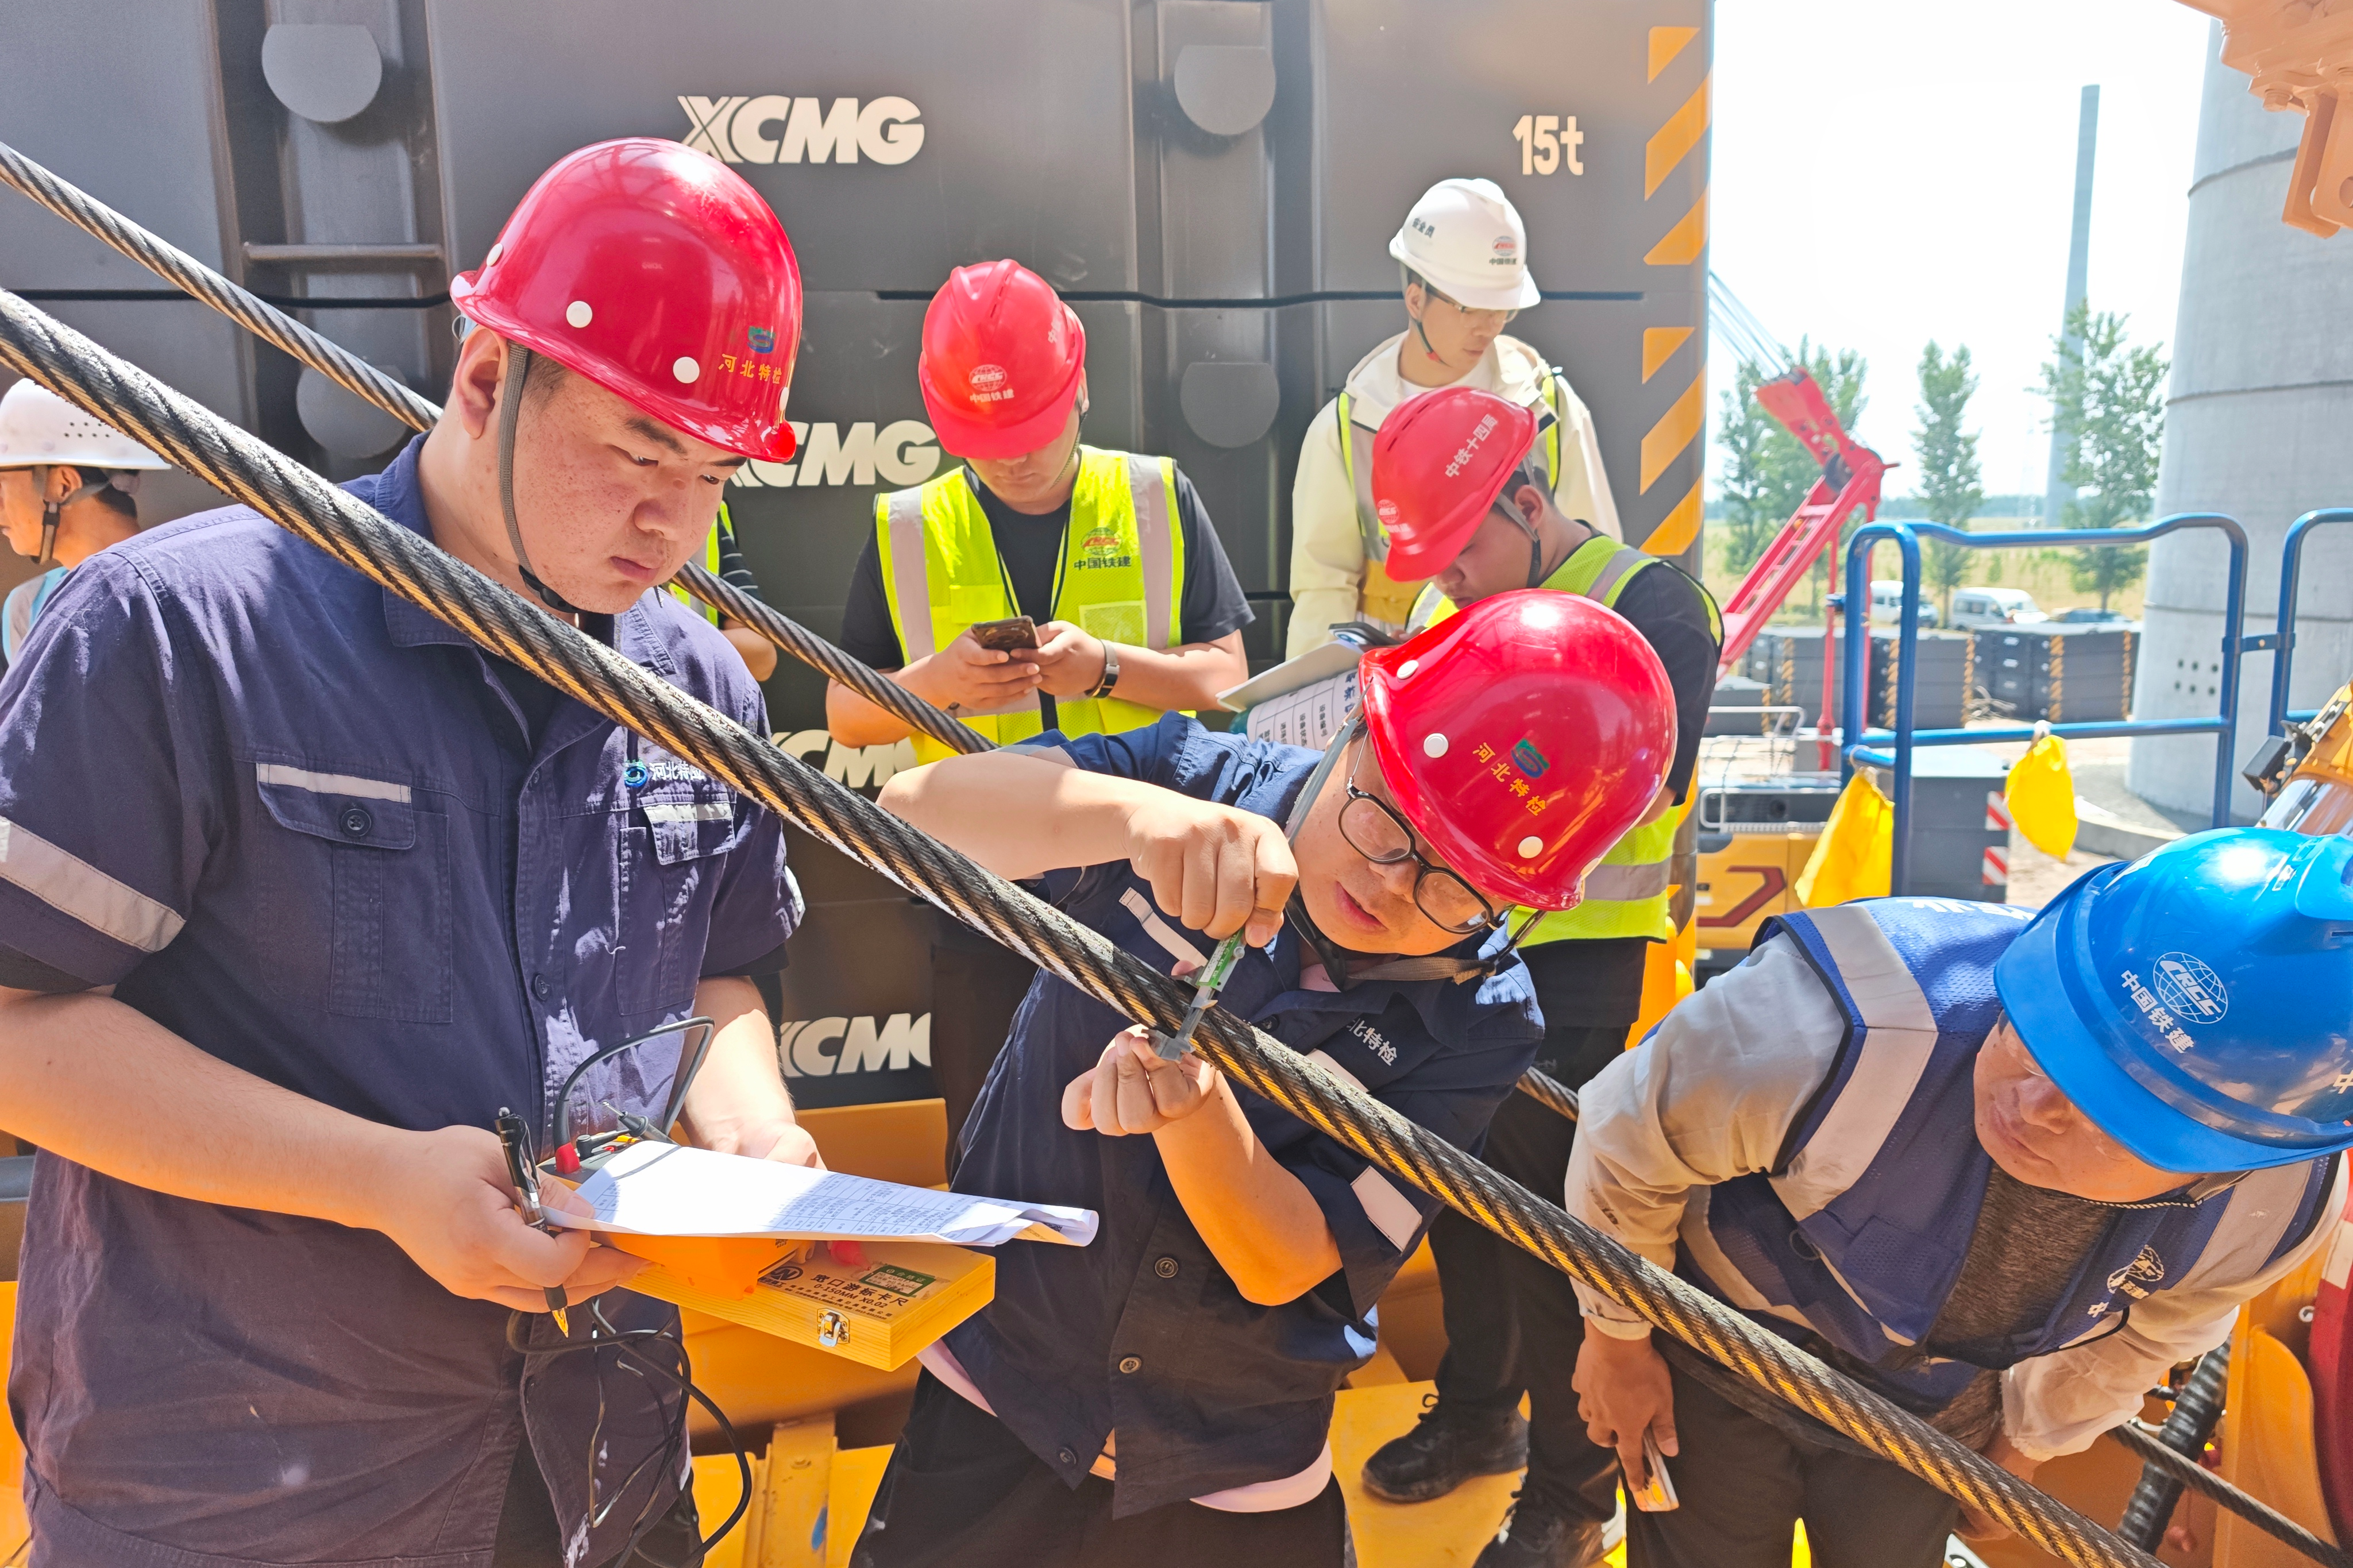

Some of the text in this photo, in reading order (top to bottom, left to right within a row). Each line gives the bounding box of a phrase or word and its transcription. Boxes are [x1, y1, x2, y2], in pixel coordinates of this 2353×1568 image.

[677, 95, 925, 165] XCMG
[1513, 115, 1584, 175] 15t
[718, 353, 782, 384] 河北特检
[730, 420, 941, 487] CMG
[1445, 414, 1498, 477] 中铁十四局
[1074, 555, 1132, 570] 中国铁建
[1472, 742, 1546, 816] 河北特检
[2121, 970, 2195, 1053] 中国铁建
[2160, 960, 2222, 1016] CRCC
[811, 1274, 909, 1307] 宽口游标卡尺
[813, 1284, 859, 1300] 0-150MM
